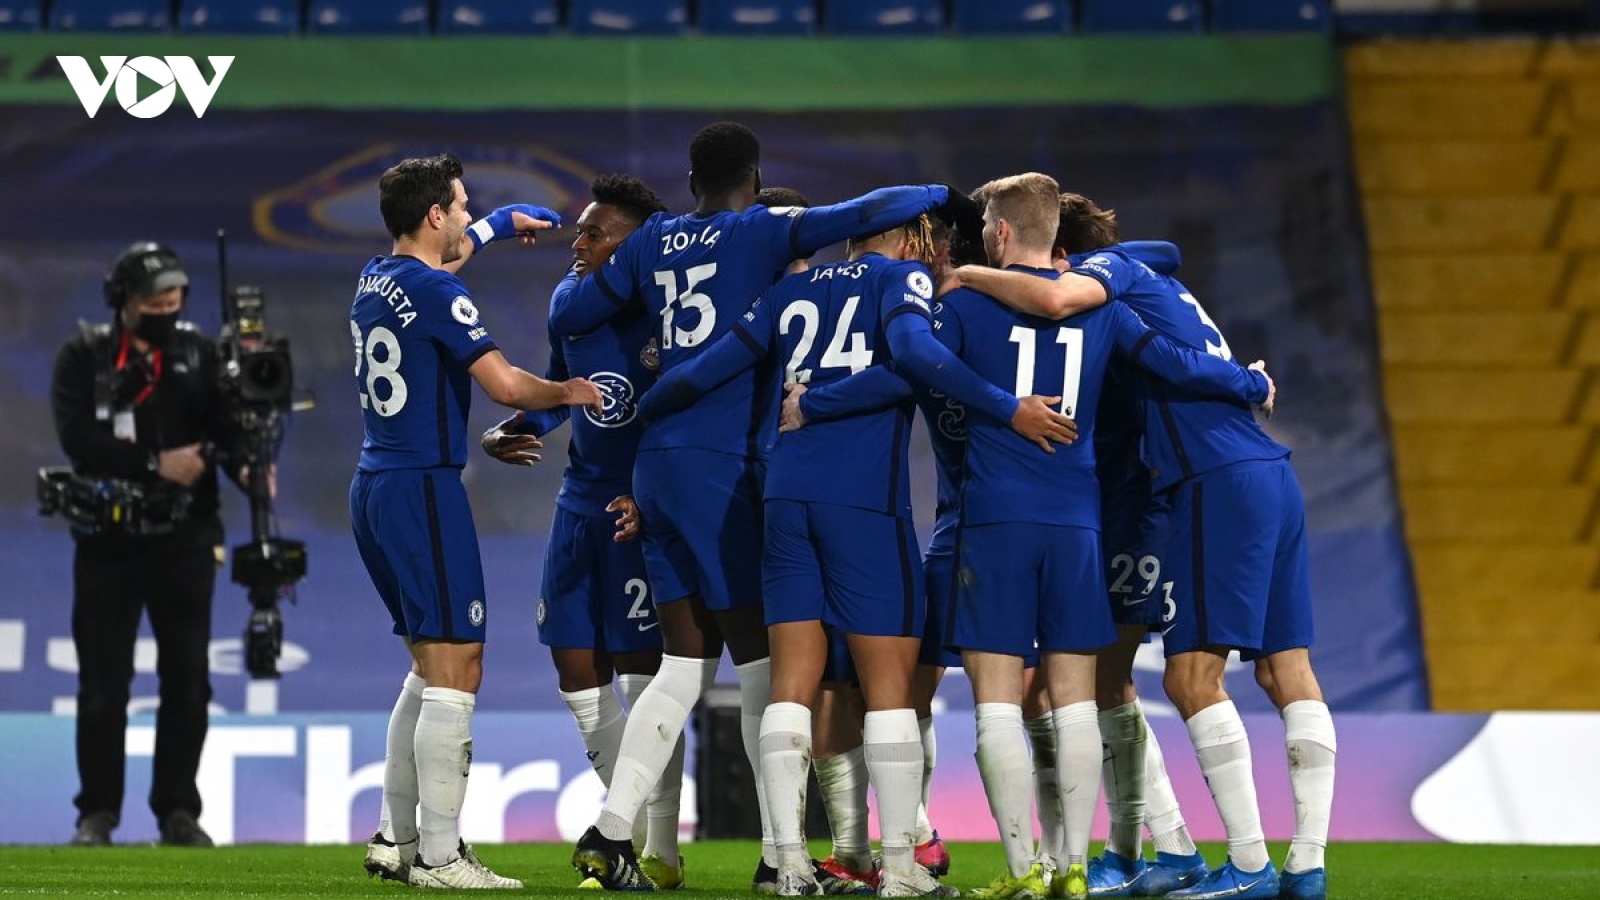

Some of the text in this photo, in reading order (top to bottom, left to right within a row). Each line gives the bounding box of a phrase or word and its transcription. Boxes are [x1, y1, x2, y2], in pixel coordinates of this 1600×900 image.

[654, 262, 718, 350] 15
[779, 295, 874, 384] 24
[1008, 325, 1084, 420] 11
[1108, 554, 1161, 595] 29
